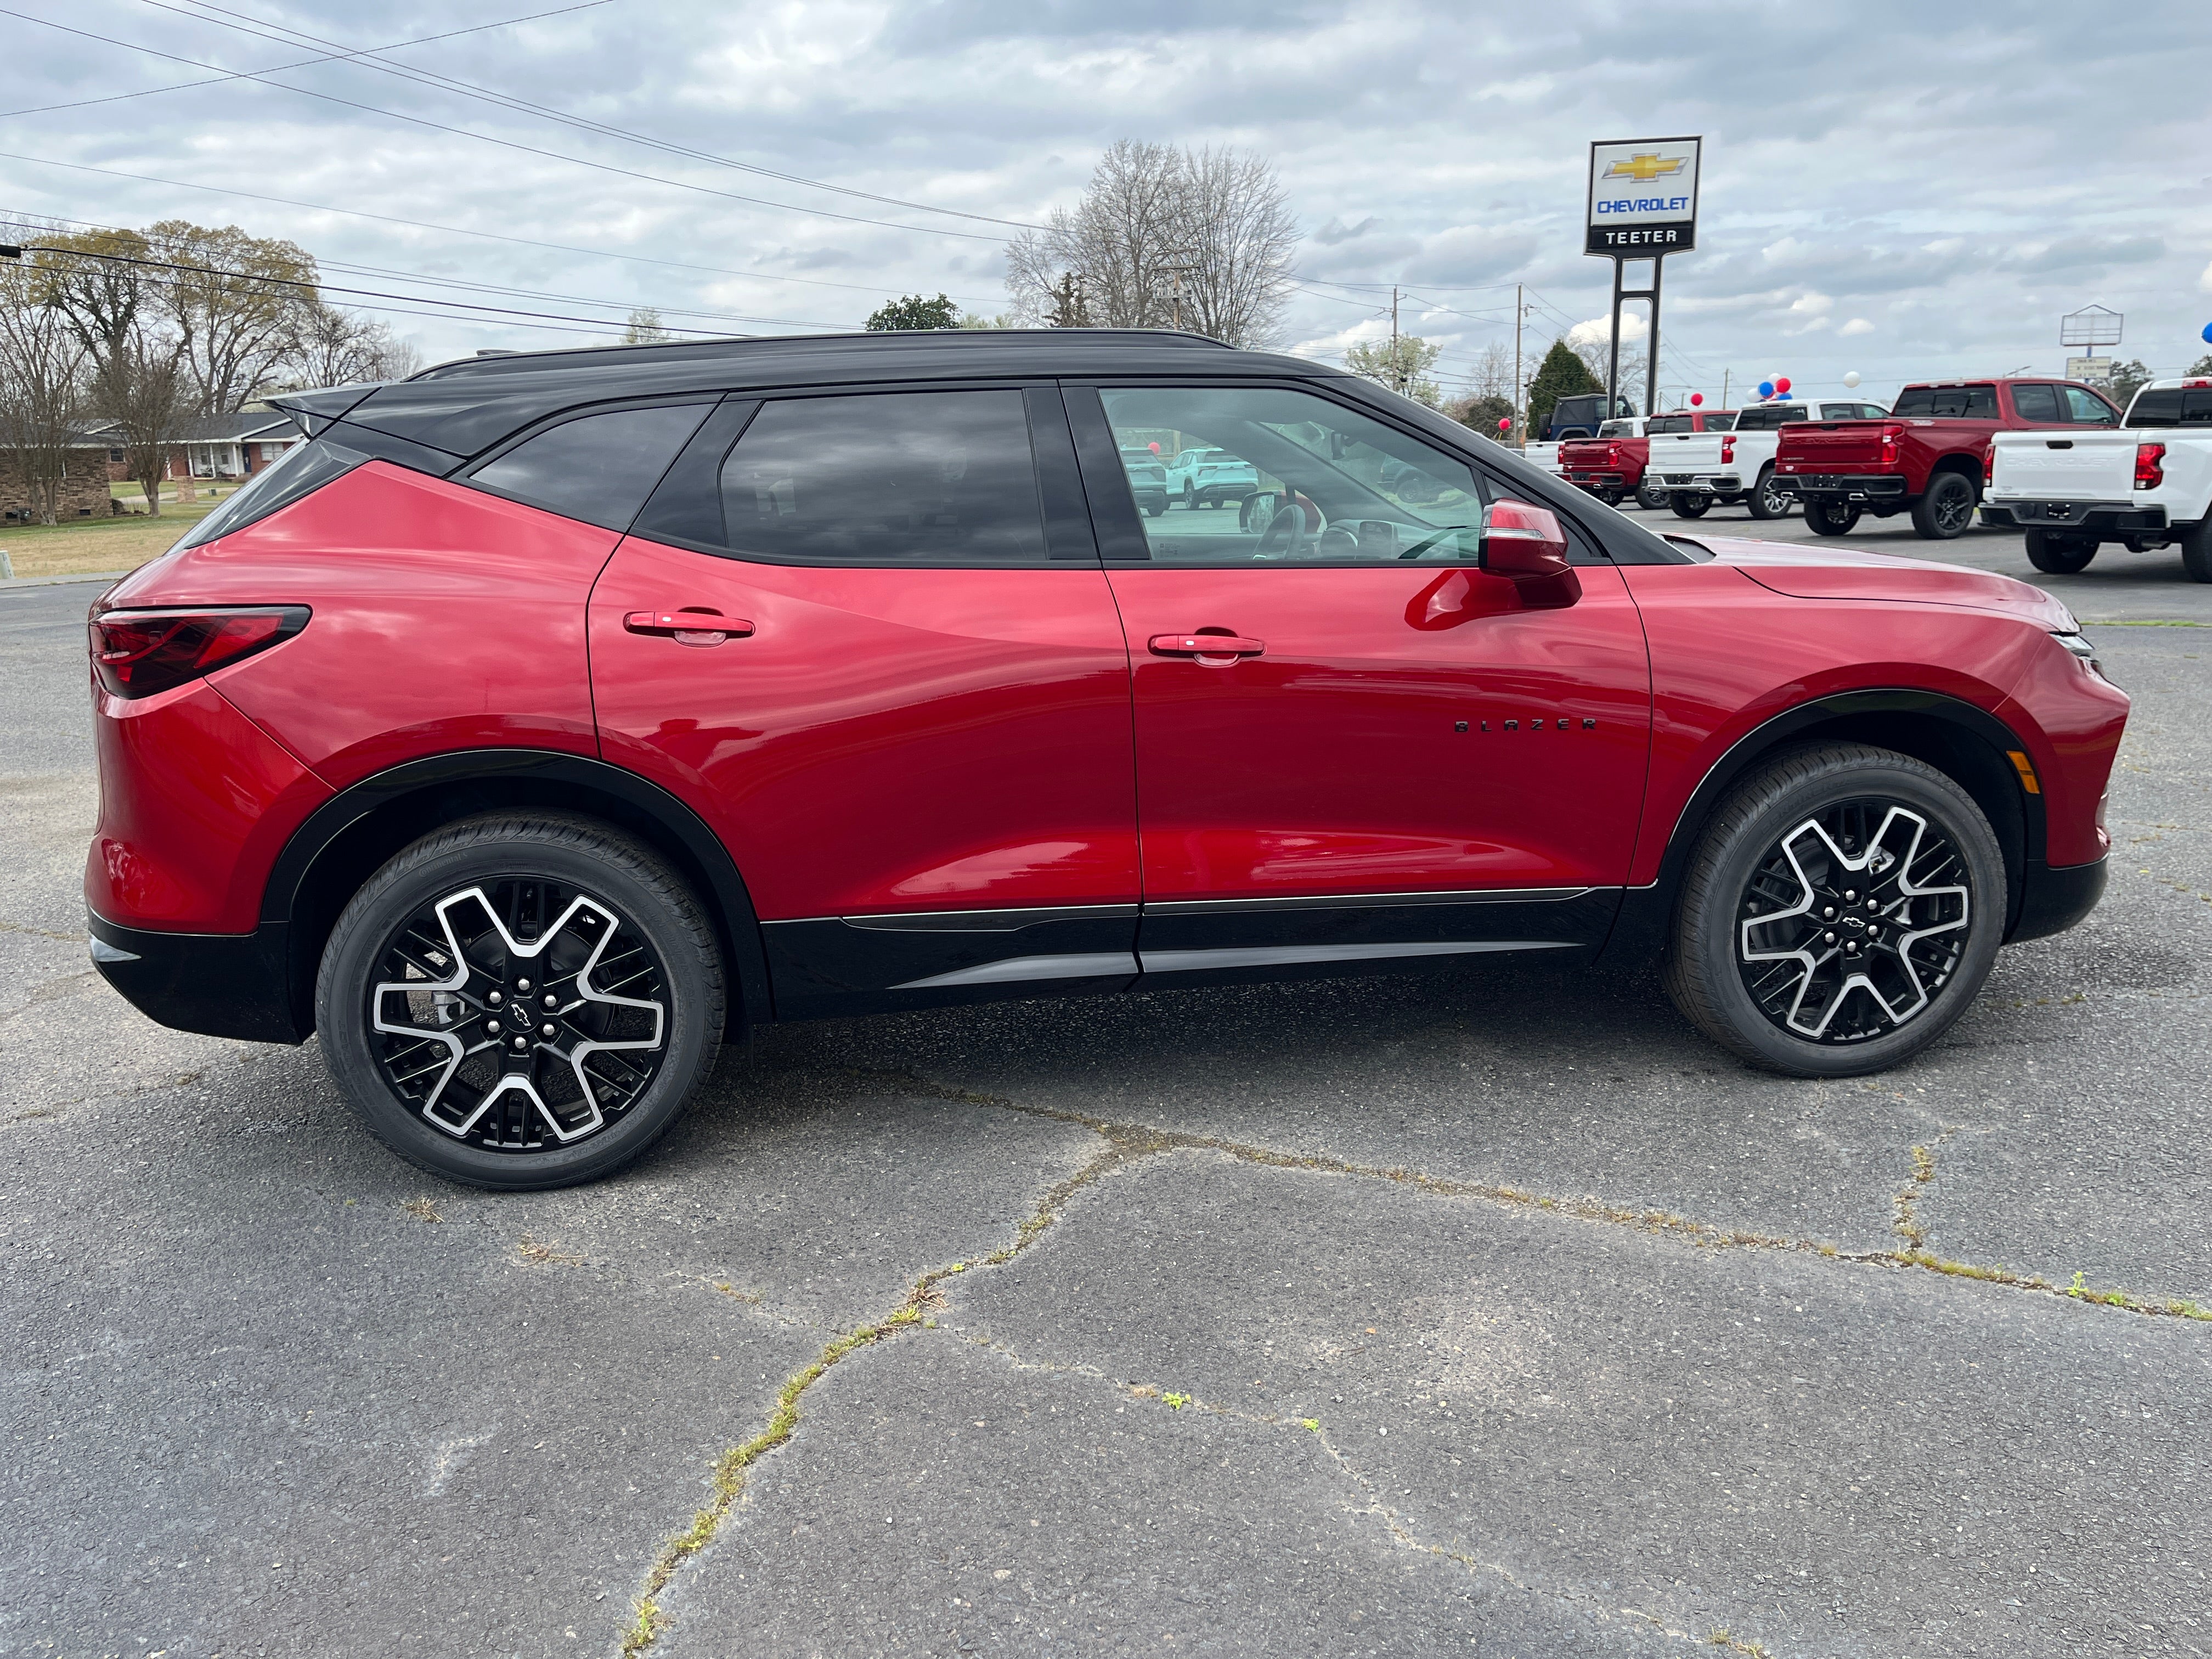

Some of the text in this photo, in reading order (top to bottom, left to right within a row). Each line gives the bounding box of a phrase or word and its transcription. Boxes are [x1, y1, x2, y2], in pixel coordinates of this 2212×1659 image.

[1597, 197, 1689, 213] CHEVROLET
[1606, 230, 1677, 244] TEETER
[1455, 719, 1596, 732] BLAZER
